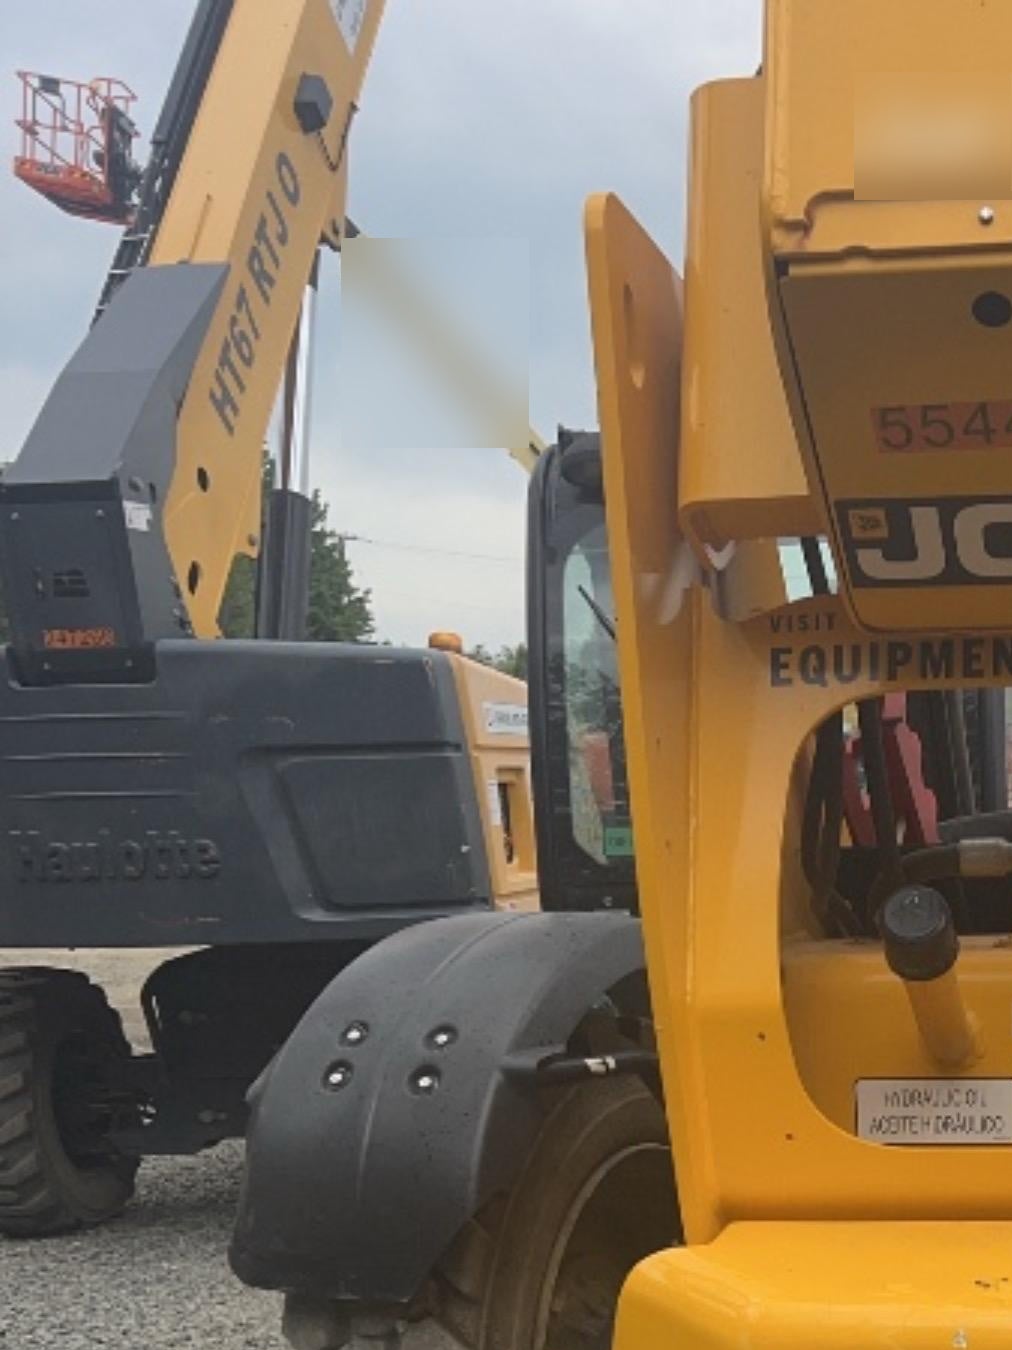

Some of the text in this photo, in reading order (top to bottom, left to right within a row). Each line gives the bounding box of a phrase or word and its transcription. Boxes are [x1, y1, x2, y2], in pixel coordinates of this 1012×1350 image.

[209, 282, 260, 436] HT67
[770, 613, 835, 632] VISIT
[965, 1088, 988, 1108] OL
[920, 1112, 1007, 1135] HDRÁULICO
